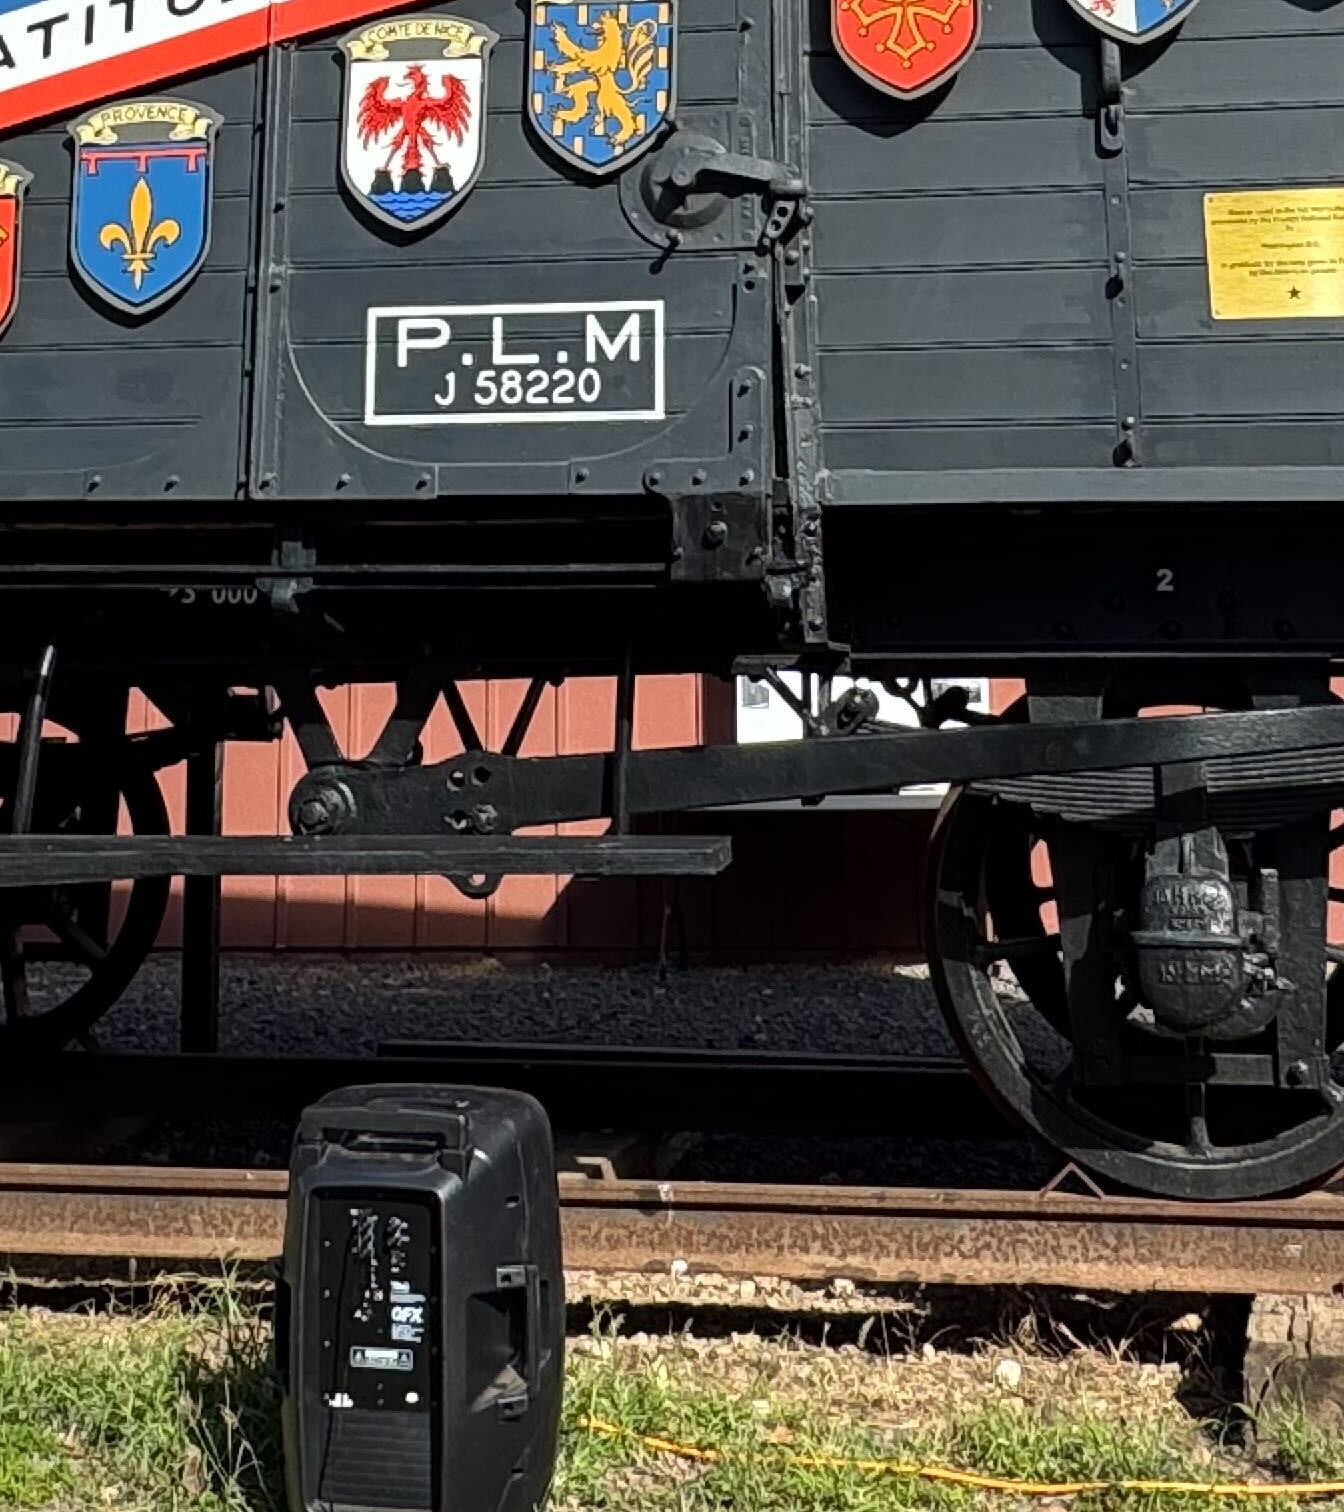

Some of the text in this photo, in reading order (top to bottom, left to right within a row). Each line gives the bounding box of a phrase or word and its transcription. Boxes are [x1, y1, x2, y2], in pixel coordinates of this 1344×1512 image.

[416, 22, 434, 36] DE
[100, 106, 188, 124] PROVENCE
[434, 367, 602, 407] J 58220
[1156, 569, 1174, 592] 2
